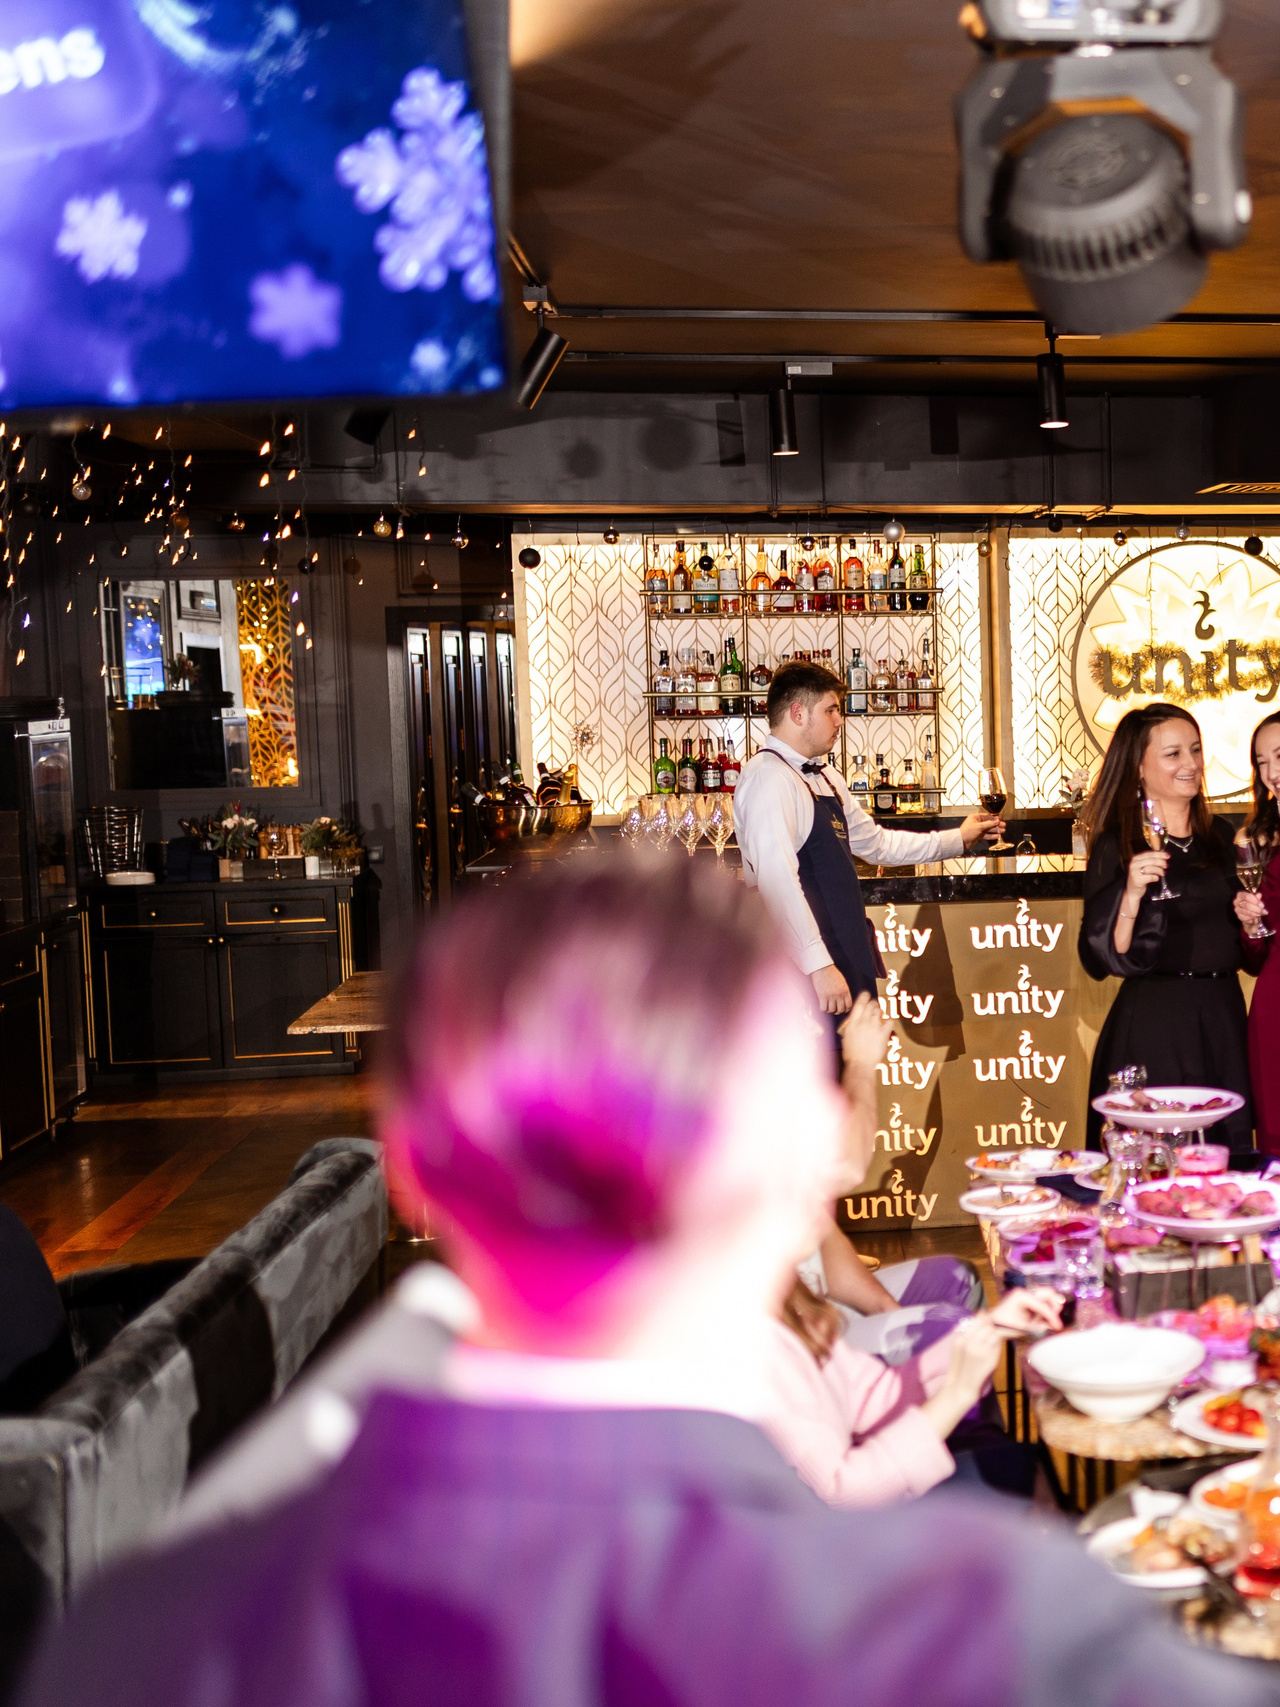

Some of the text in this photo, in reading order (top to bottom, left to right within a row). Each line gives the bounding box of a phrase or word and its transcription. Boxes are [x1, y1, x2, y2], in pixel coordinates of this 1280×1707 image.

[970, 899, 1063, 952] unity
[972, 965, 1064, 1018] unity
[875, 1036, 935, 1089] nity
[973, 1030, 1066, 1083] unity
[873, 1102, 937, 1156] nity
[975, 1096, 1067, 1148] unity
[845, 1169, 938, 1221] unity
